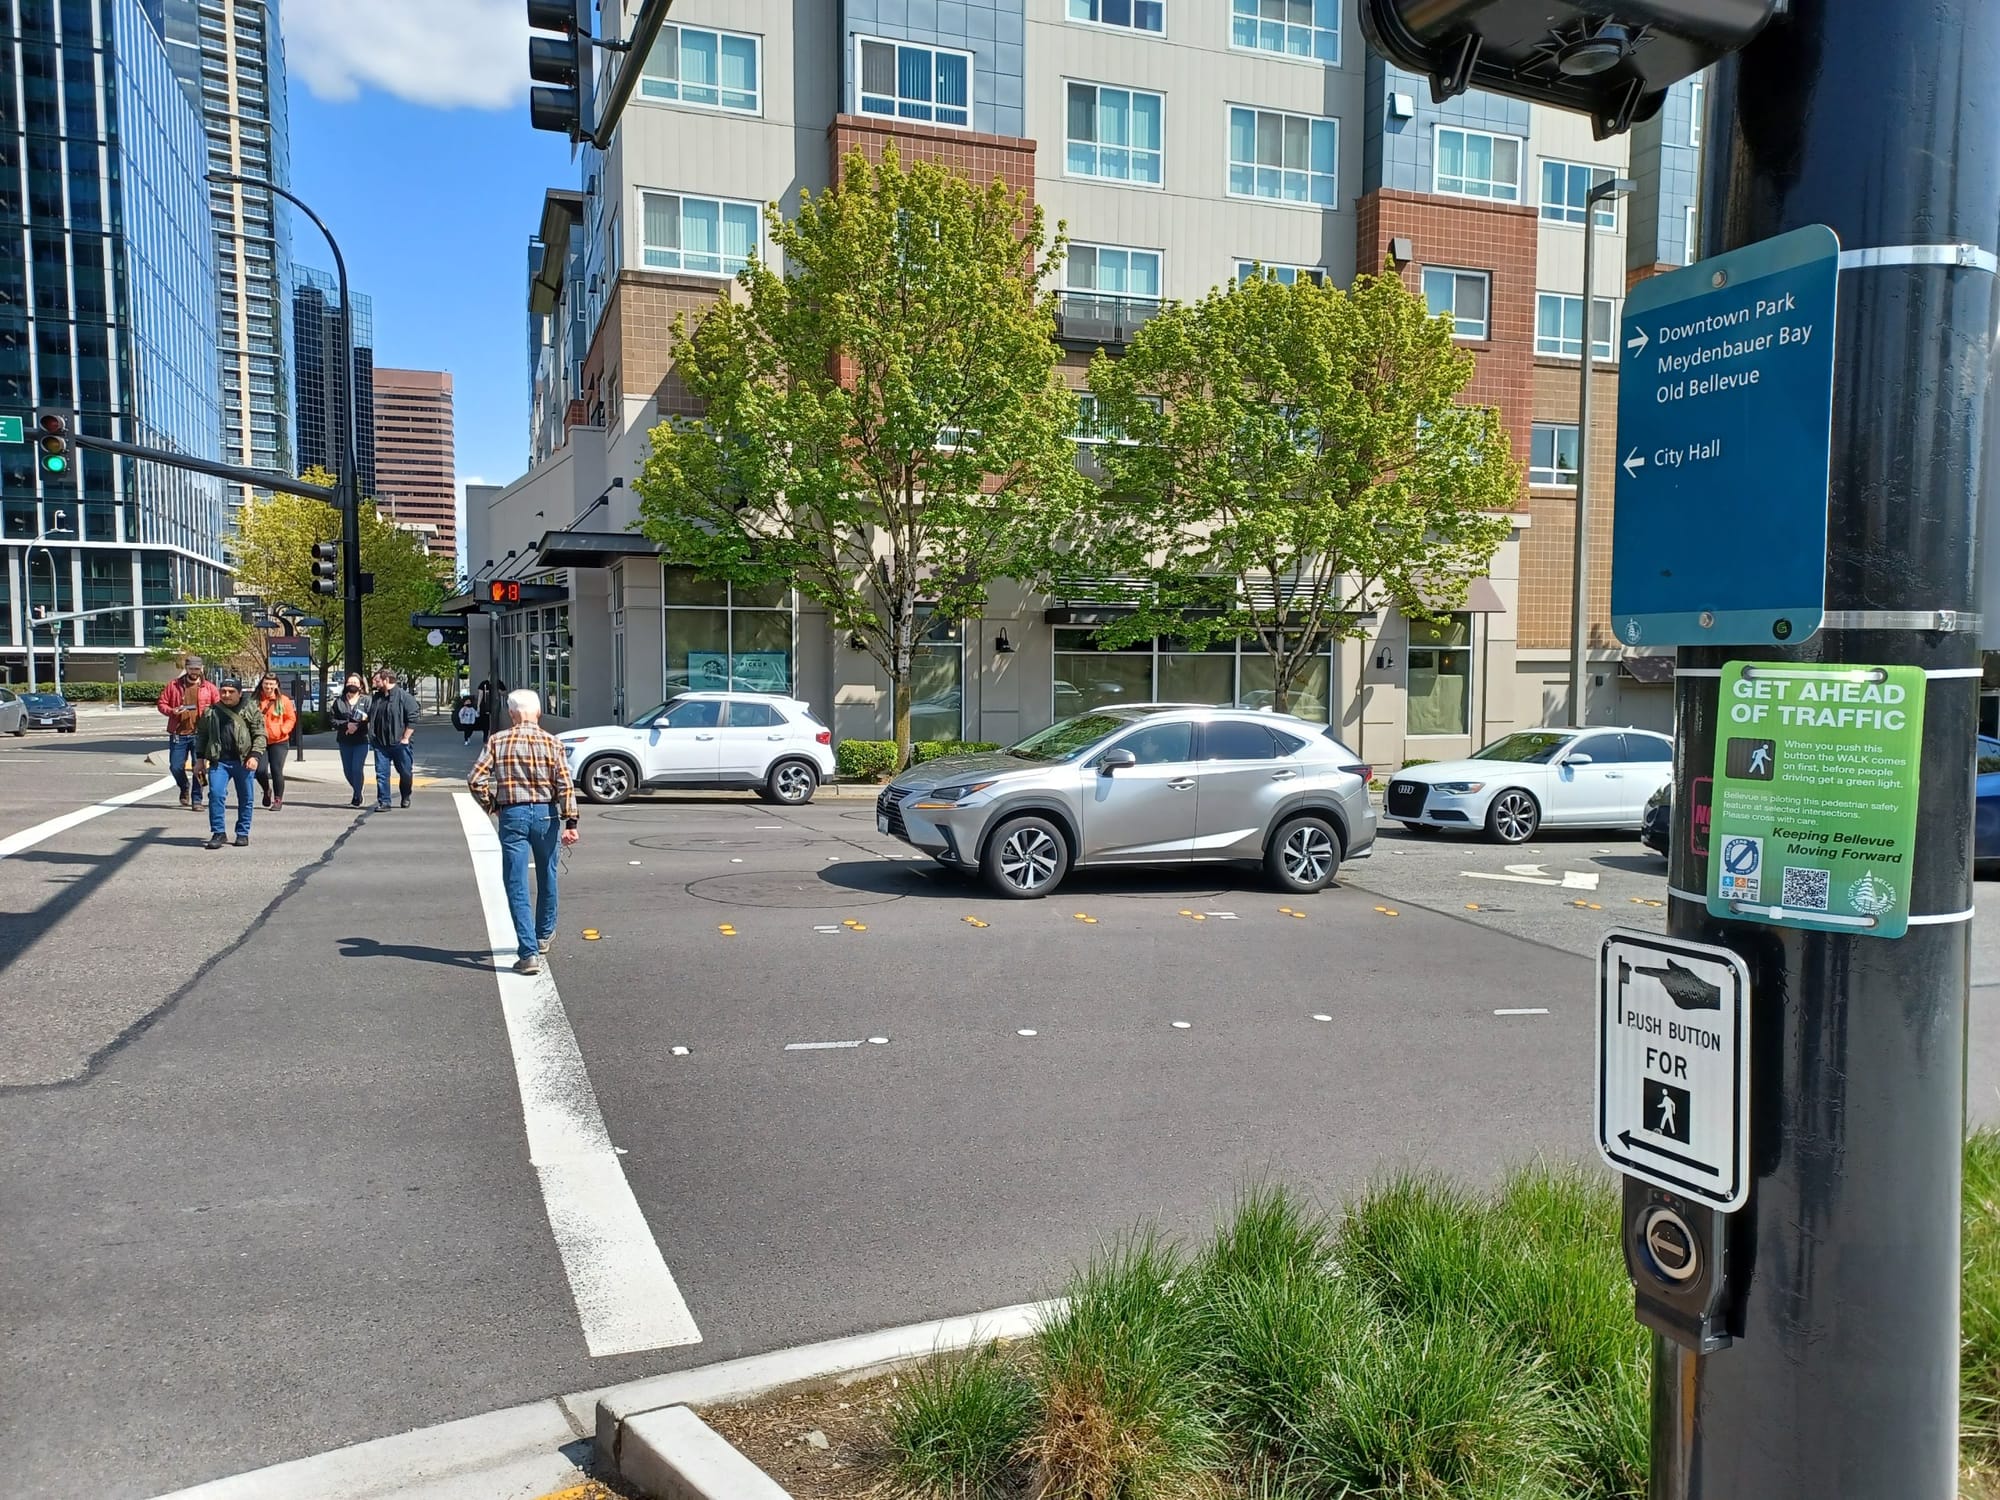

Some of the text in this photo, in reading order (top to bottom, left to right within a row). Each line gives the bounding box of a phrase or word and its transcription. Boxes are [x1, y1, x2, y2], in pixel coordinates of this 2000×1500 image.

[1659, 292, 1795, 344] Downtown Park
[1658, 325, 1813, 374] Meydenbauer Bay
[1657, 370, 1760, 403] Old Bellevue
[1654, 439, 1720, 468] City Hall
[508, 584, 518, 600] 13
[1733, 679, 1906, 705] GET AHEAD
[1731, 703, 1906, 731] OF TRAFFIC
[1784, 740, 1883, 753] When you push this
[1784, 751, 1906, 766] button the WALK comes
[1798, 763, 1819, 772] first,
[1823, 765, 1855, 774] before
[1858, 768, 1893, 777] people
[1782, 773, 1815, 784] driving
[1818, 776, 1834, 785] get
[1846, 778, 1875, 786] green
[1878, 779, 1904, 789] light.
[1723, 801, 1752, 809] feature
[1764, 805, 1800, 814] selected
[1802, 808, 1861, 819] intersections.
[1724, 791, 1759, 800] Bellevue
[1770, 795, 1801, 805] piloting
[1804, 797, 1819, 805] this
[1822, 800, 1869, 809] pedestrian
[1871, 803, 1899, 813] safety
[1723, 811, 1750, 819] Please
[1772, 827, 1895, 847] Keeping Bellevue
[1787, 843, 1903, 863] Moving Forward
[1722, 890, 1758, 901] SAFE
[1627, 1011, 1721, 1052] PUSH BUTTON
[1646, 1047, 1687, 1080] FOR
